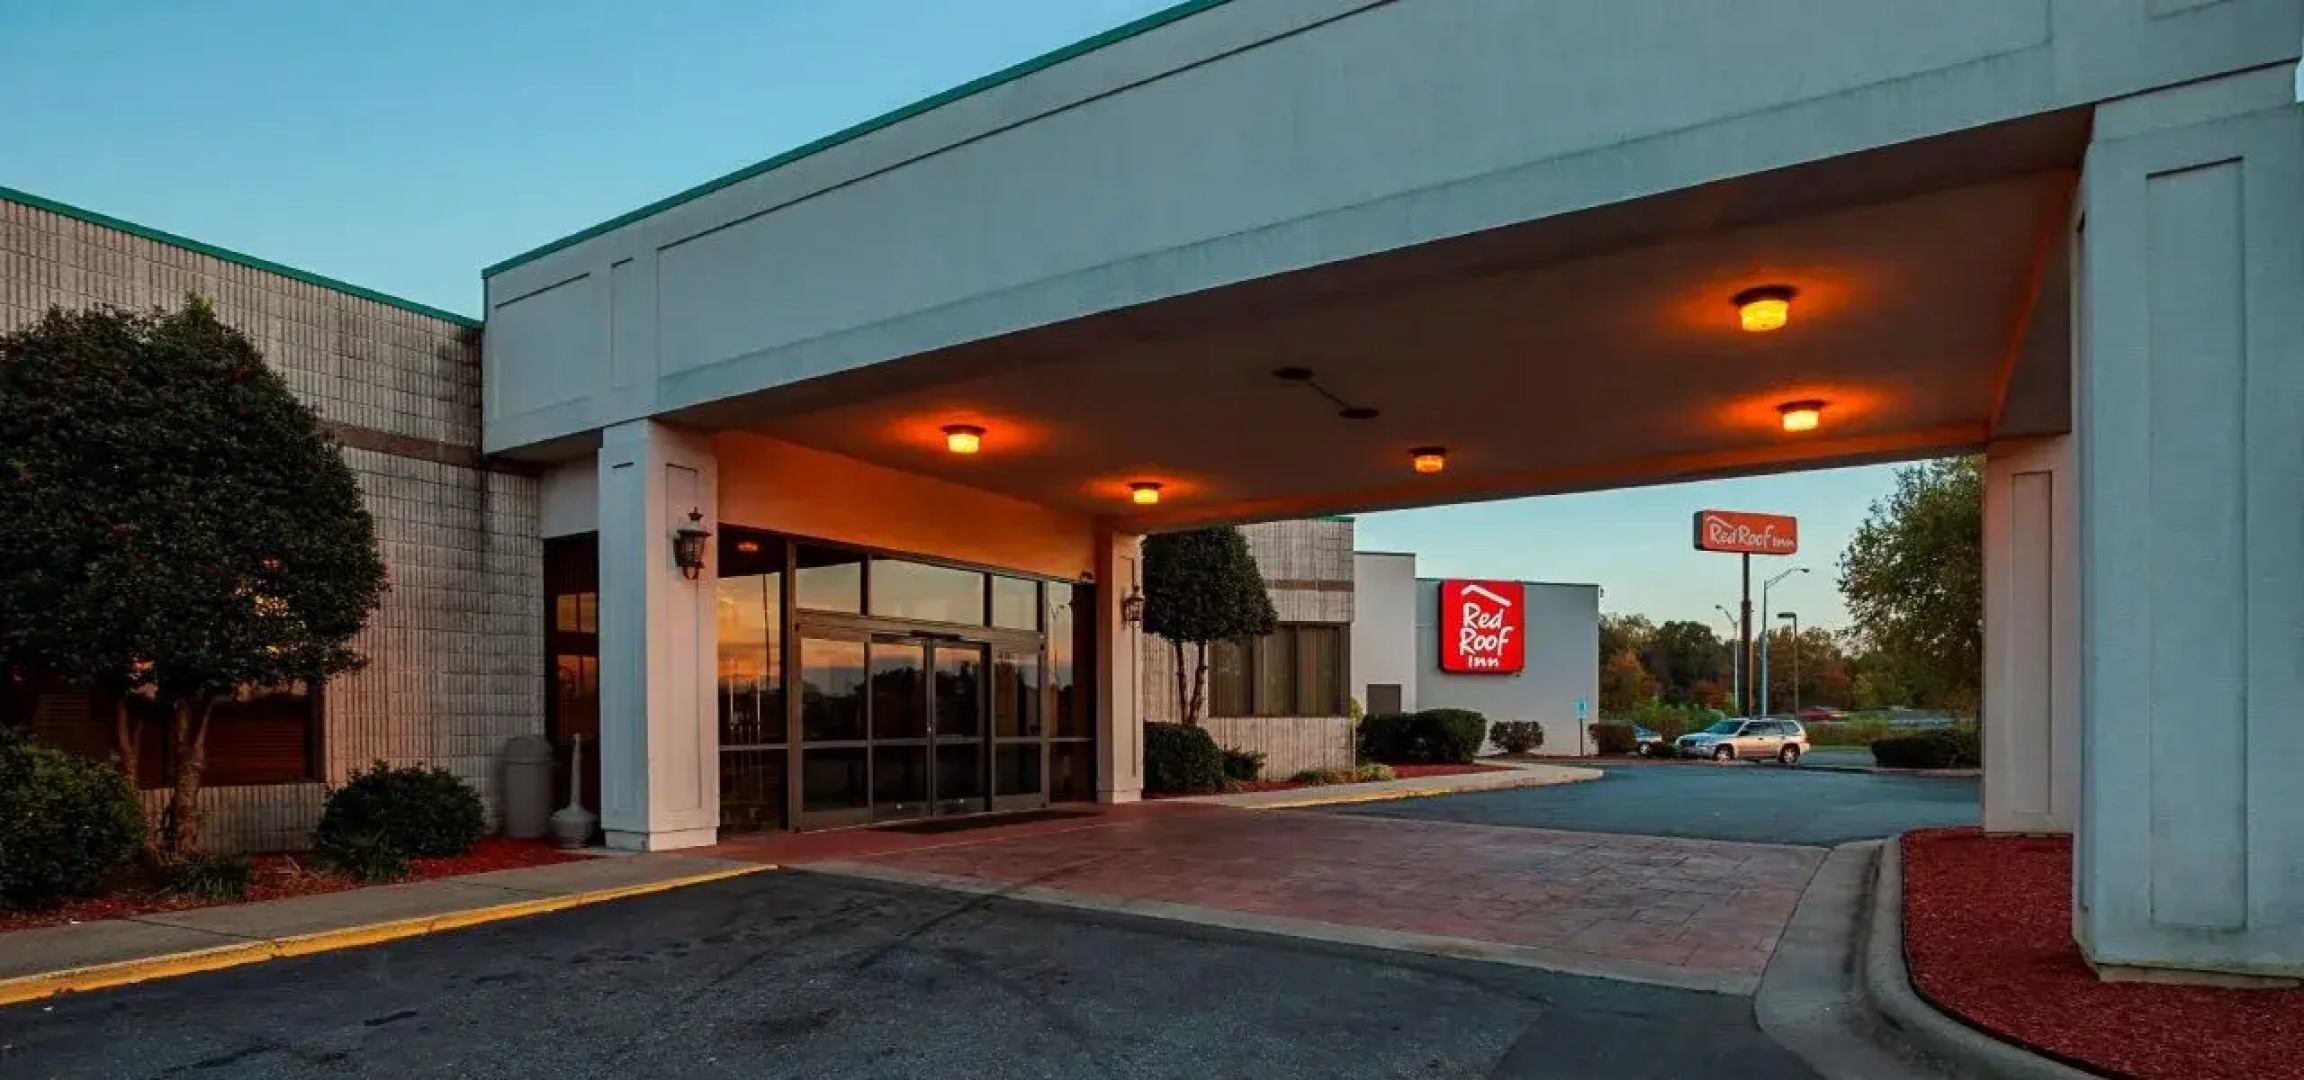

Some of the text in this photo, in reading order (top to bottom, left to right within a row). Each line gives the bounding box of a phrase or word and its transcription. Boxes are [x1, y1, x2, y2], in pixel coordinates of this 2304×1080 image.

[1709, 522, 1737, 544] Red
[1738, 525, 1775, 548] Roof
[1463, 602, 1504, 628] Red
[1460, 626, 1514, 655] Roof
